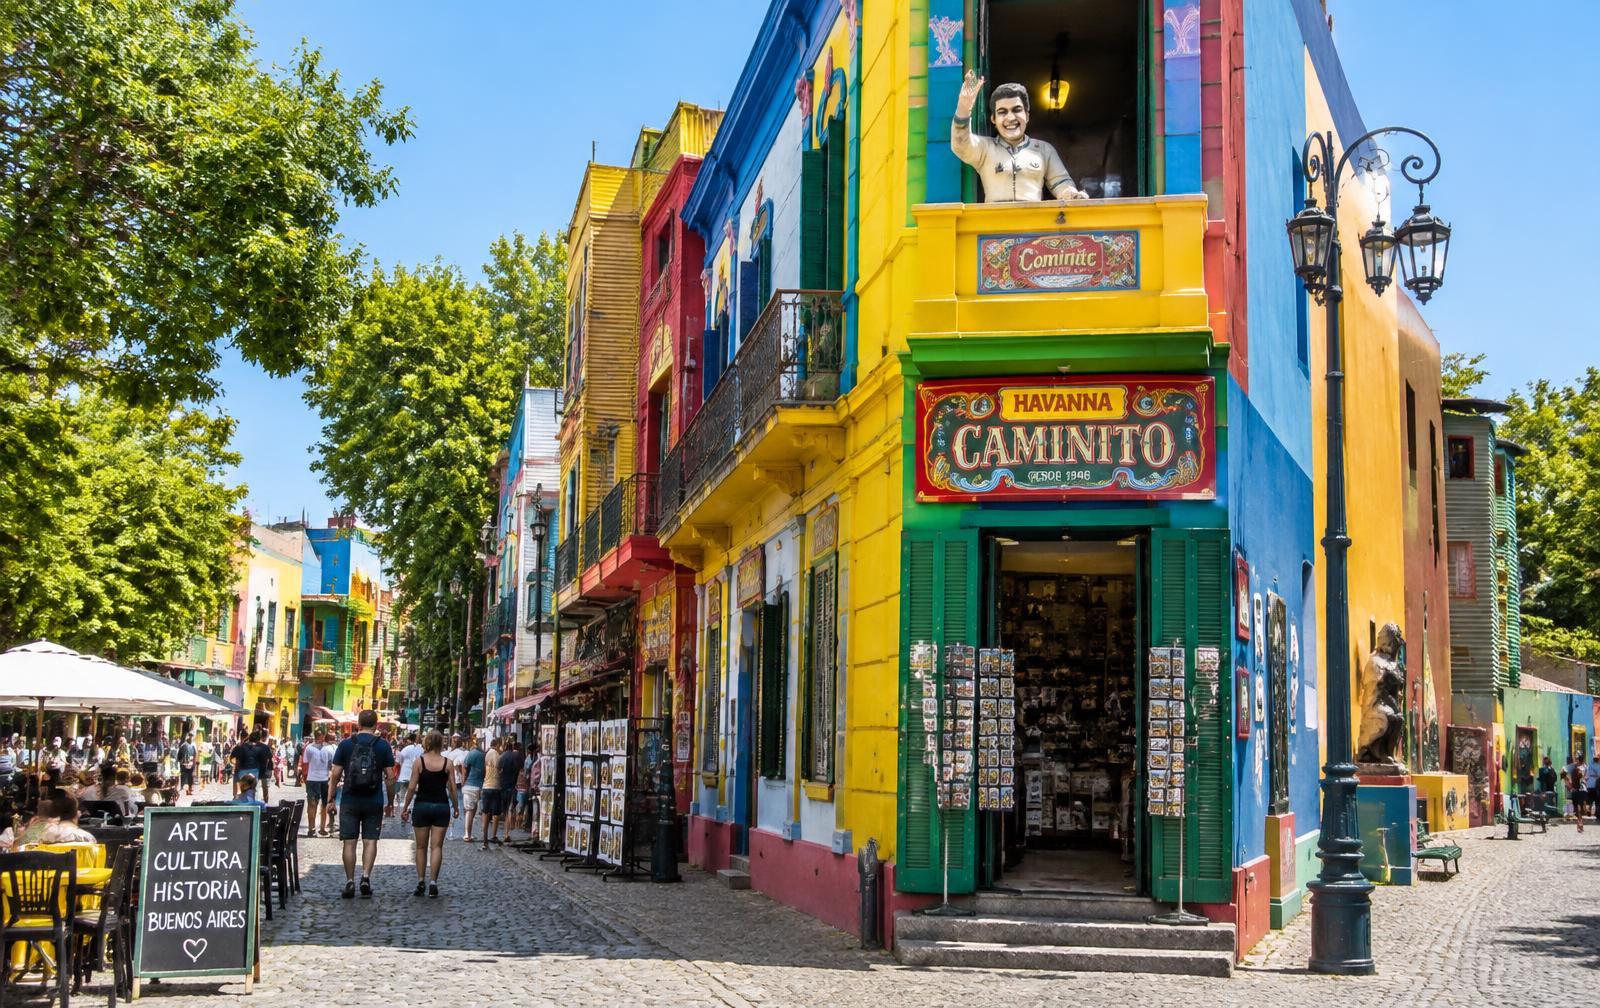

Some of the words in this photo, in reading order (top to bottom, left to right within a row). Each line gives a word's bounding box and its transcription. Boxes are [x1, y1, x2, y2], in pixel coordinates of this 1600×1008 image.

[1014, 394, 1112, 412] HAVANNA
[952, 423, 1176, 469] CAMINITO
[168, 821, 228, 842] ARTE
[154, 850, 243, 871] CULTURA
[148, 910, 203, 931] BUENOS
[206, 909, 246, 929] AIRES
